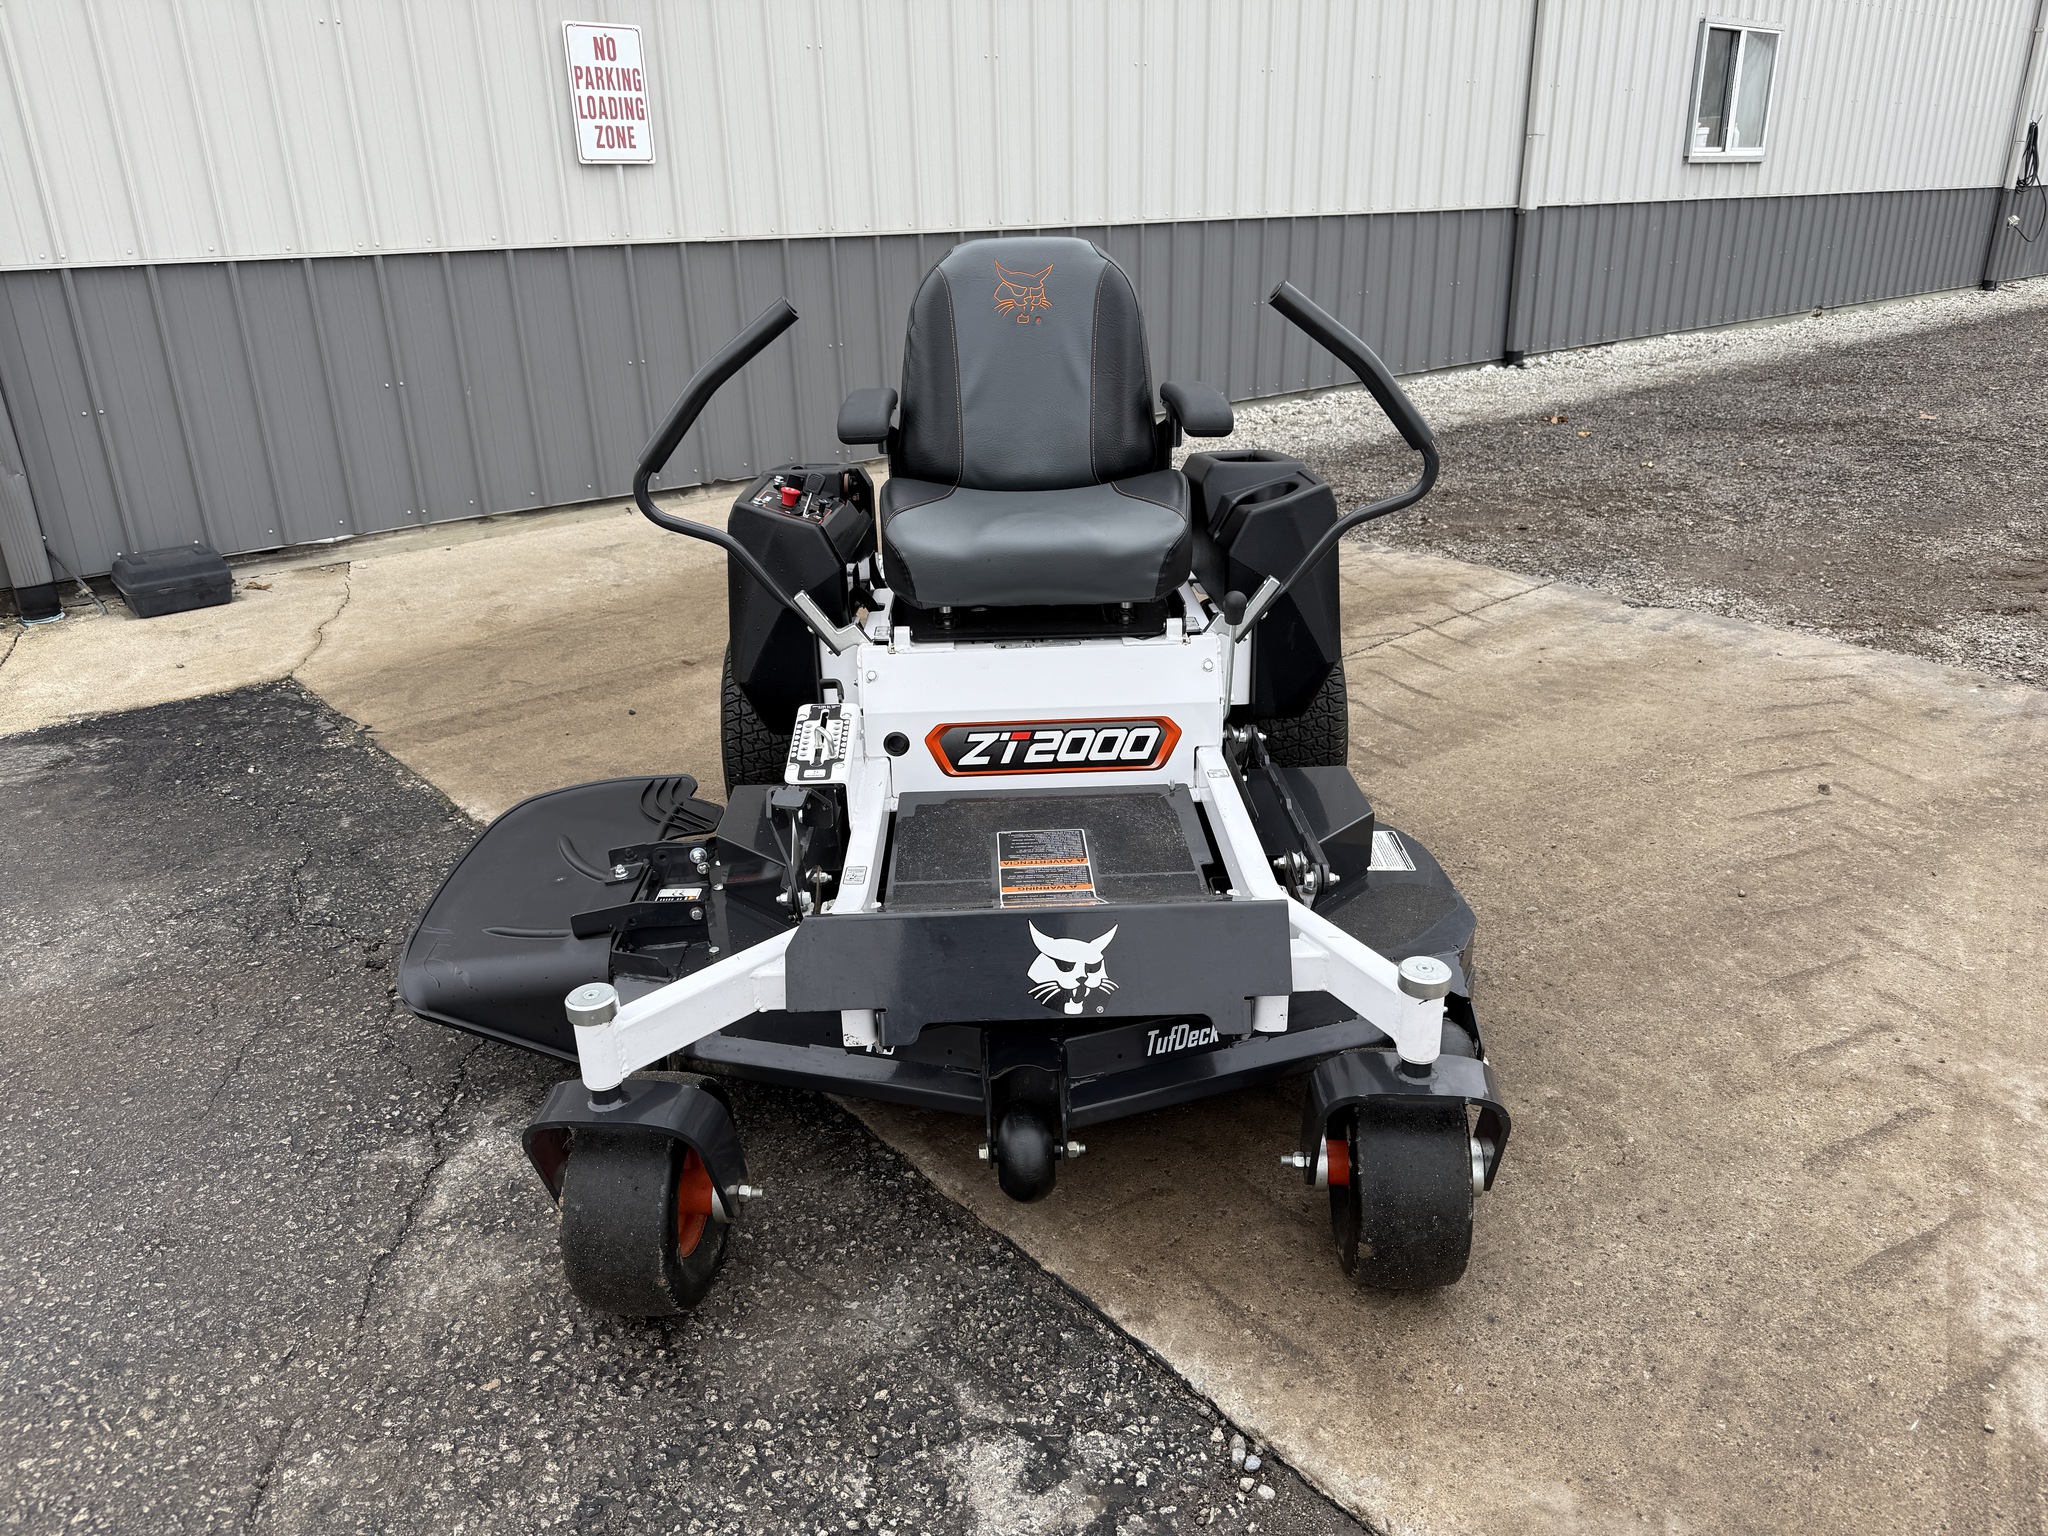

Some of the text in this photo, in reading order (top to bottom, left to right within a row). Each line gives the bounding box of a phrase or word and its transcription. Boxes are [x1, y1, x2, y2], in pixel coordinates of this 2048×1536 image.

[593, 36, 617, 62] NO
[573, 65, 643, 92] PARKING
[577, 95, 646, 121] LOADING
[594, 125, 637, 149] ZONE
[957, 726, 1162, 767] ZT2000
[1146, 1023, 1219, 1057] TufDeck
